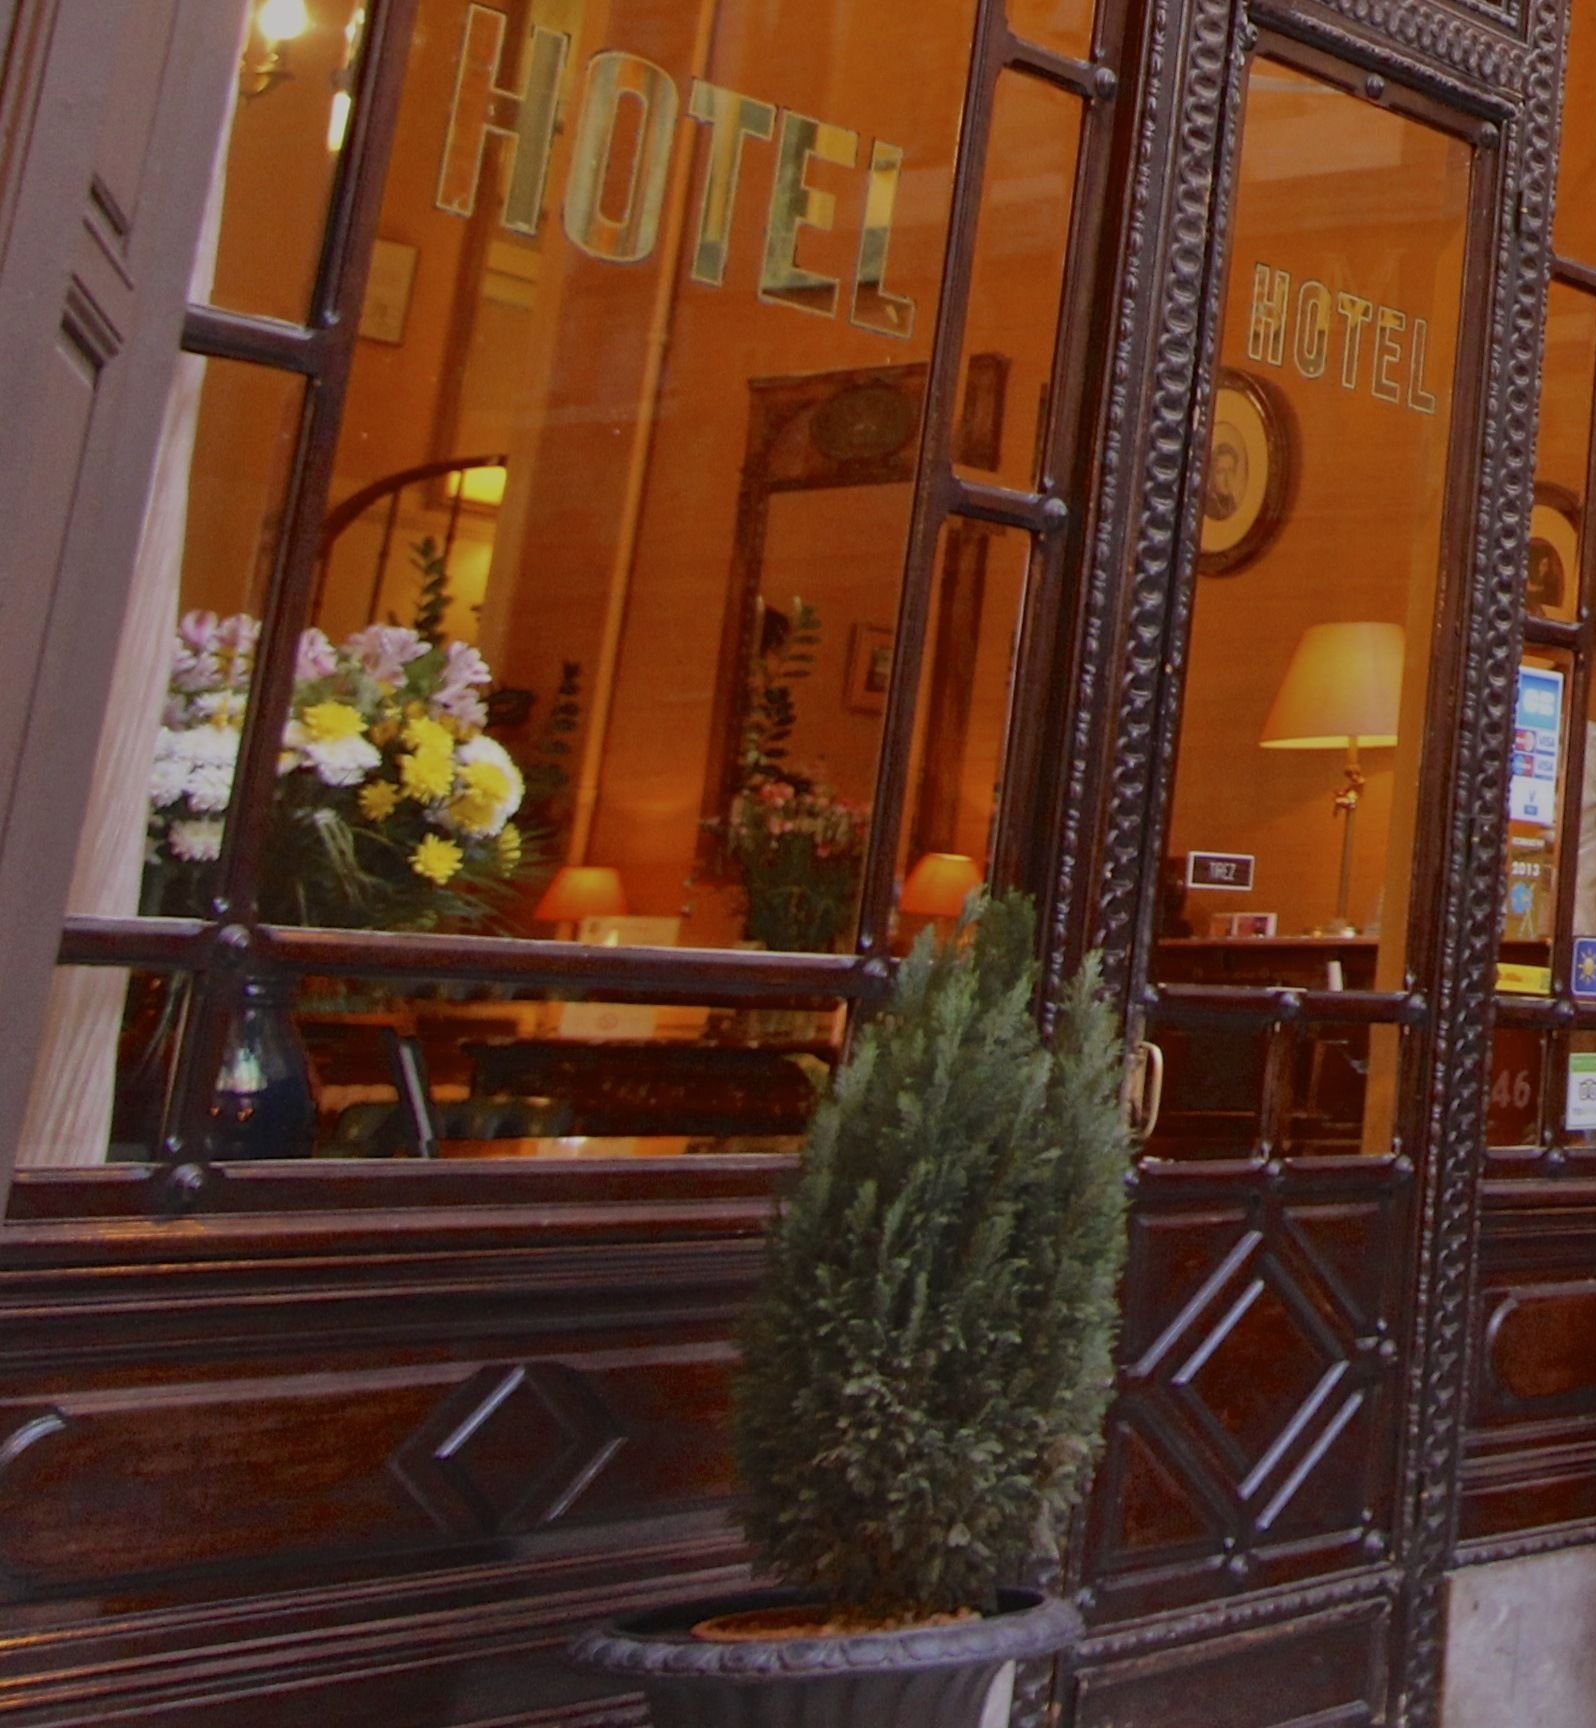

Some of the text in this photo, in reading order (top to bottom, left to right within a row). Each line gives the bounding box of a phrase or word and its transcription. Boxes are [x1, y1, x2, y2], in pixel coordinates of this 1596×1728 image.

[435, 2, 917, 340] HOTEL
[1248, 262, 1436, 415] HOTEL
[1511, 861, 1541, 877] 2013
[1491, 1069, 1532, 1110] 46
